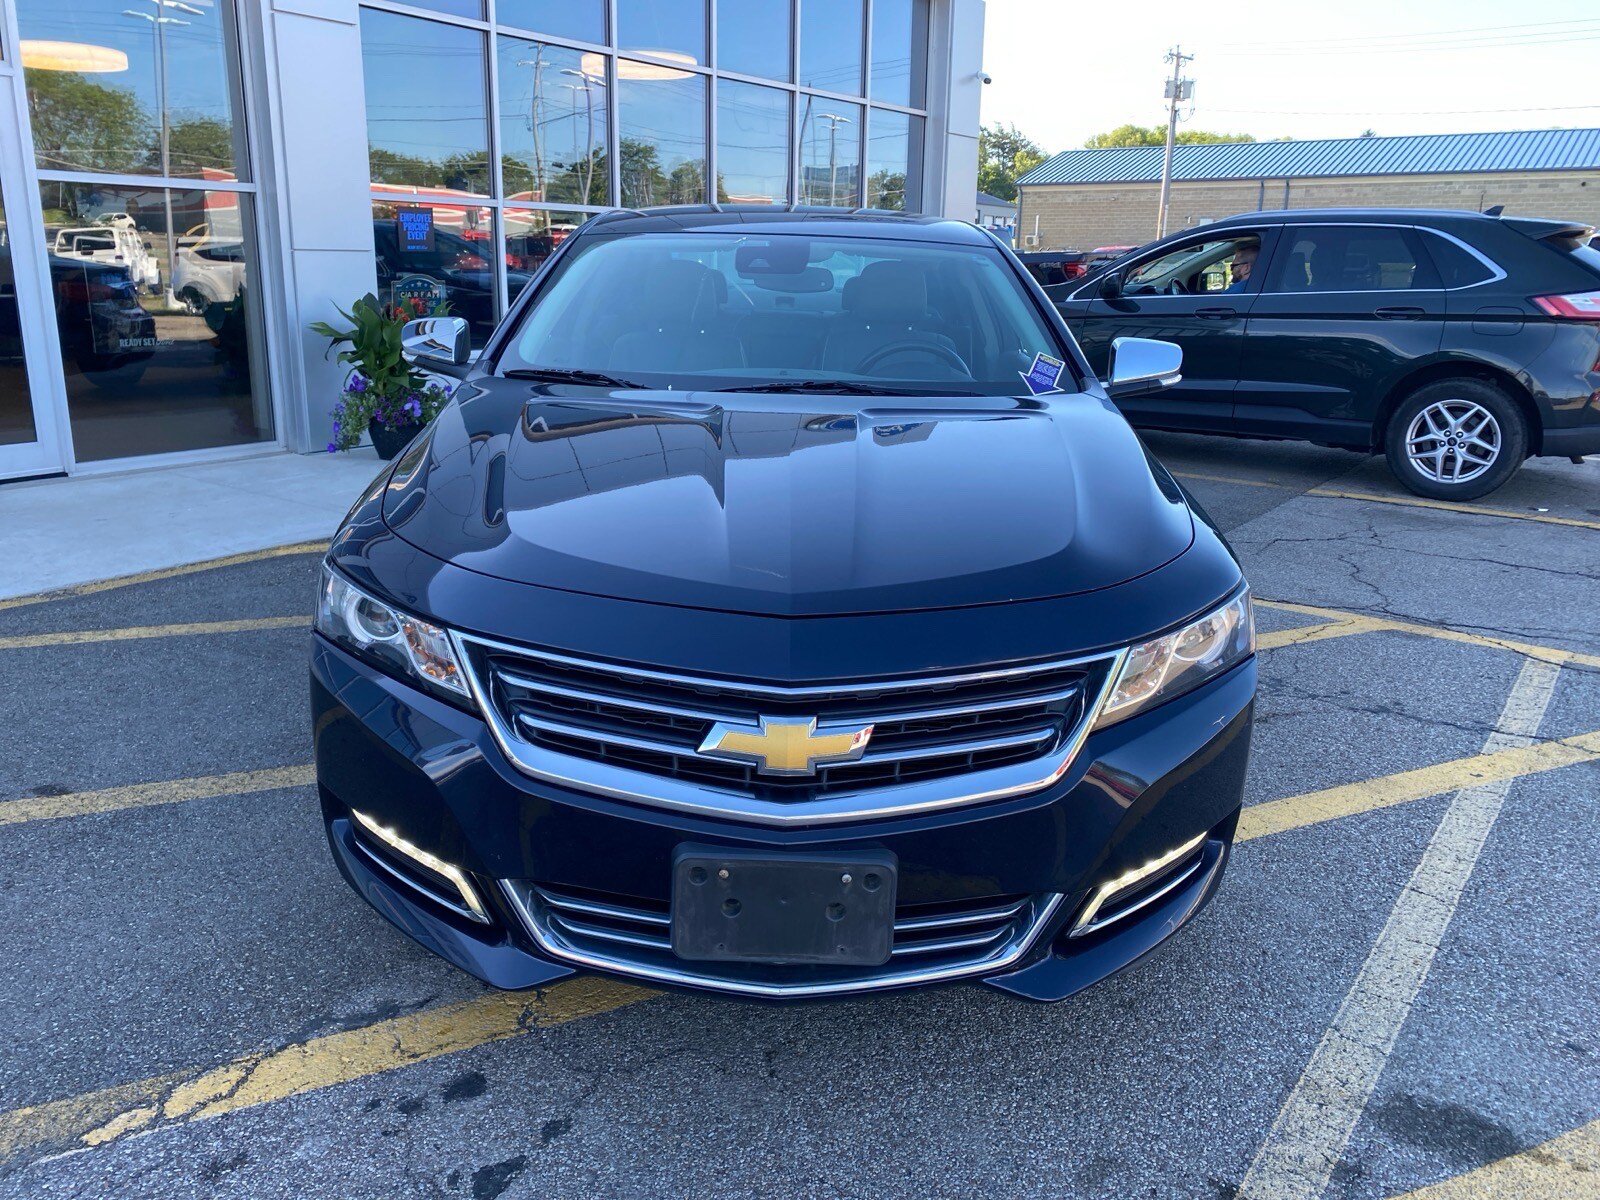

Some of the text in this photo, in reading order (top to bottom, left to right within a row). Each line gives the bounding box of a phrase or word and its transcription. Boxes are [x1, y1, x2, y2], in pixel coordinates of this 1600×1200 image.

[400, 213, 432, 223] EMPLOYEE
[403, 222, 429, 231] PRICING
[407, 231, 427, 240] EVENT
[400, 290, 440, 298] CARFAX
